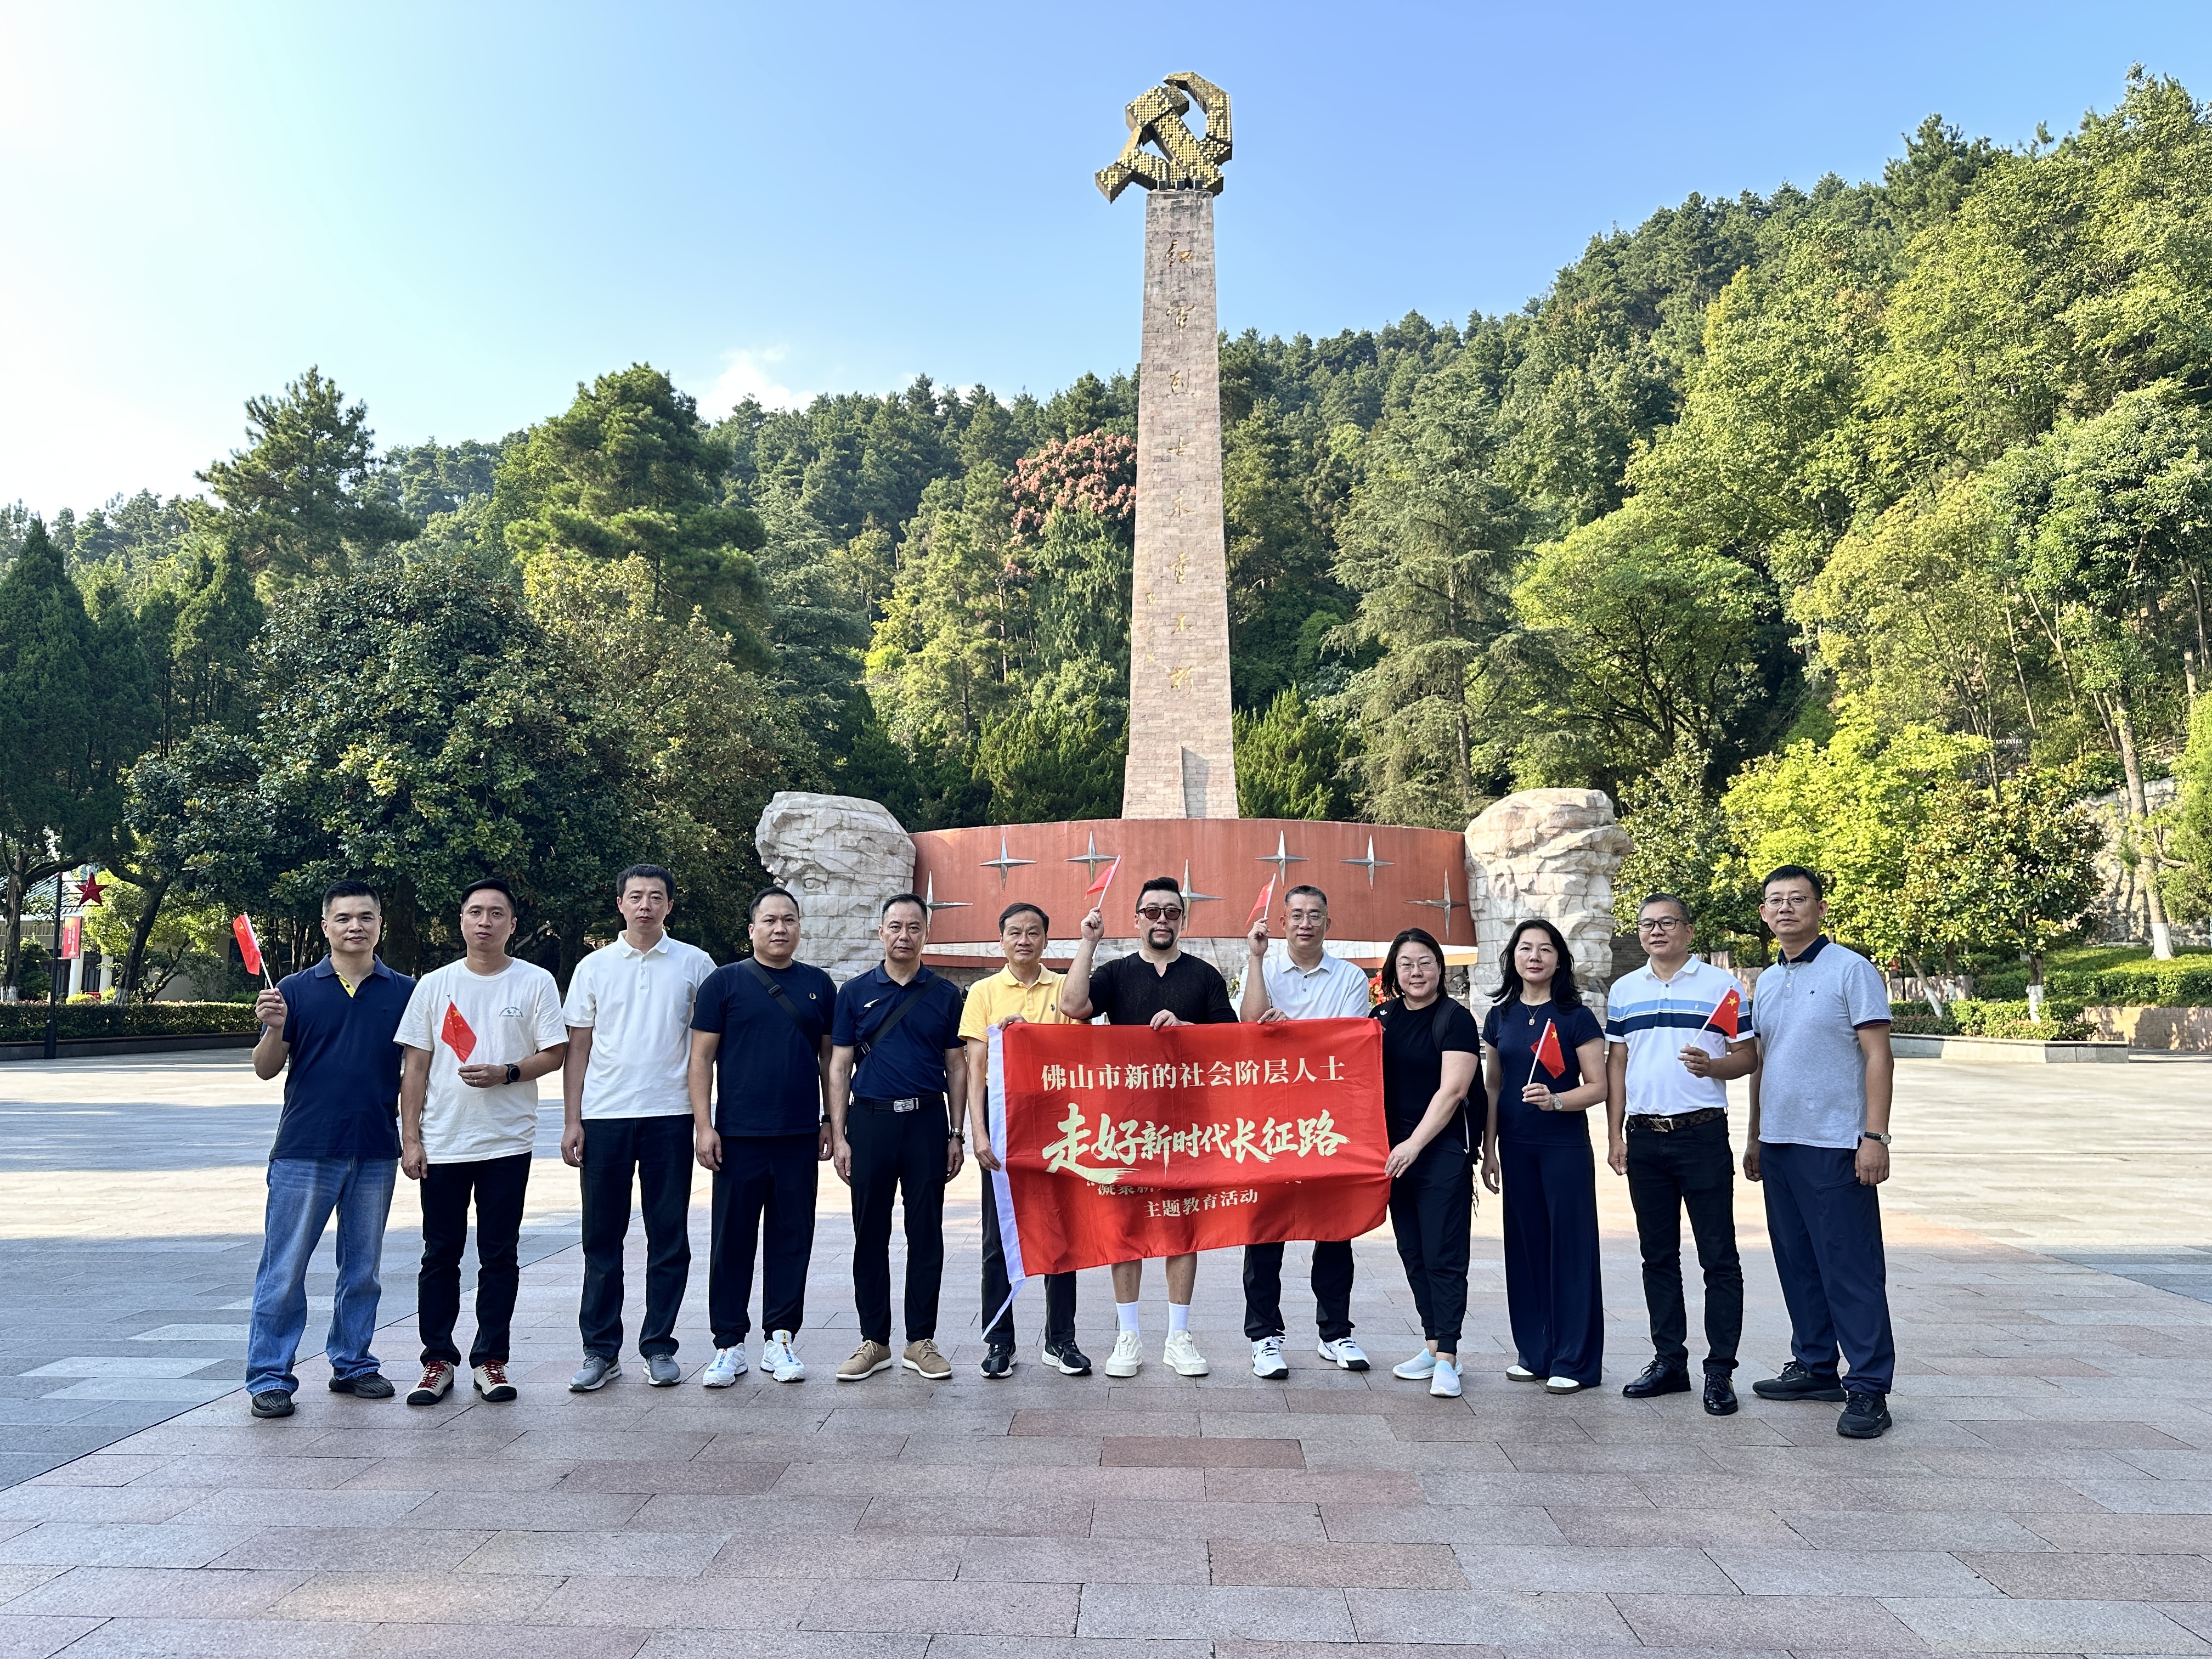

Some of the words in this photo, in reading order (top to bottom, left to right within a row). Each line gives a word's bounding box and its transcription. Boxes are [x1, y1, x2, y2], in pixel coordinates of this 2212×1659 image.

[1041, 1055, 1345, 1091] 佛山市新的社会阶层人士
[1042, 1102, 1352, 1184] 走好新时代长征路
[1143, 1189, 1259, 1218] 主题教育活动
